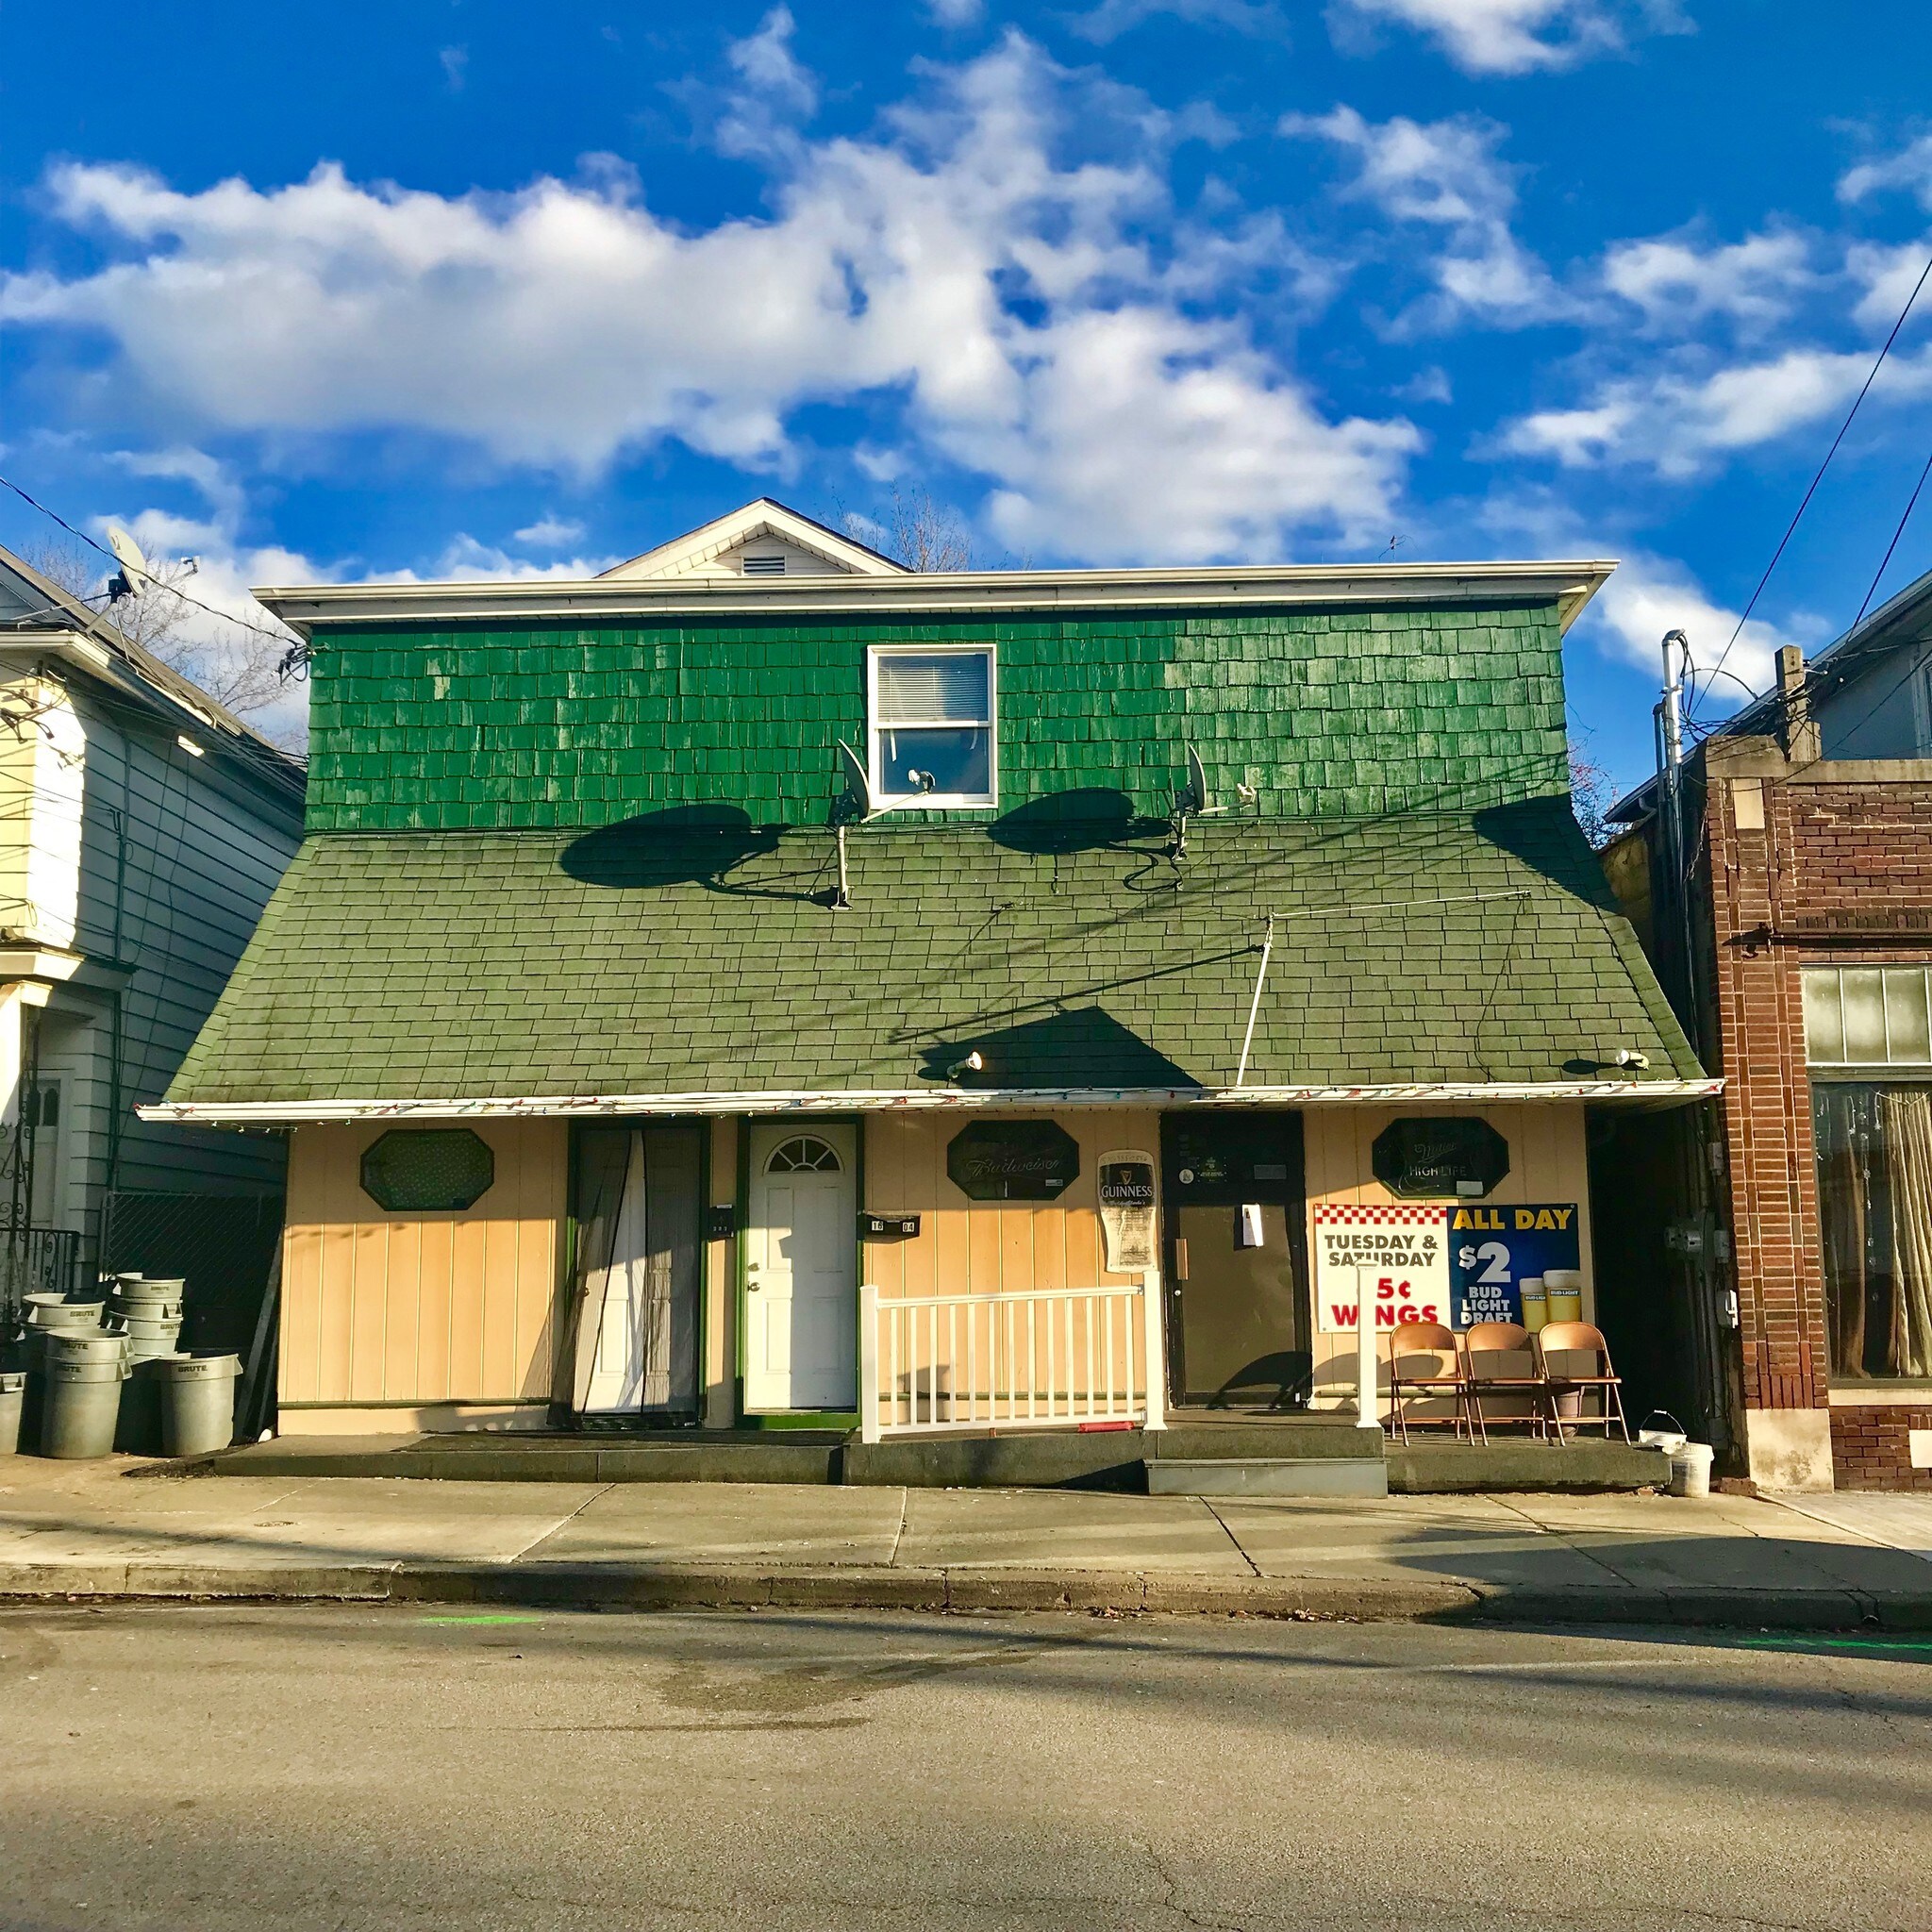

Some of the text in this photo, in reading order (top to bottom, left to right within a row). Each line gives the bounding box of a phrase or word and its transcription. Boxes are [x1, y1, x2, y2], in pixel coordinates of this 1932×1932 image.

[966, 1158, 1060, 1177] Budweiser
[1409, 1165, 1467, 1177] HIGH LIFE
[1101, 1185, 1153, 1198] GUINNESS
[1453, 1209, 1573, 1230] ALL DAY
[1324, 1235, 1439, 1250] TUESDAY &
[1458, 1241, 1511, 1283] $2
[1469, 1287, 1502, 1298] BUD
[1461, 1299, 1510, 1311] LIGHT
[1331, 1305, 1439, 1326] WNGS
[1460, 1312, 1512, 1324] DRAFT
